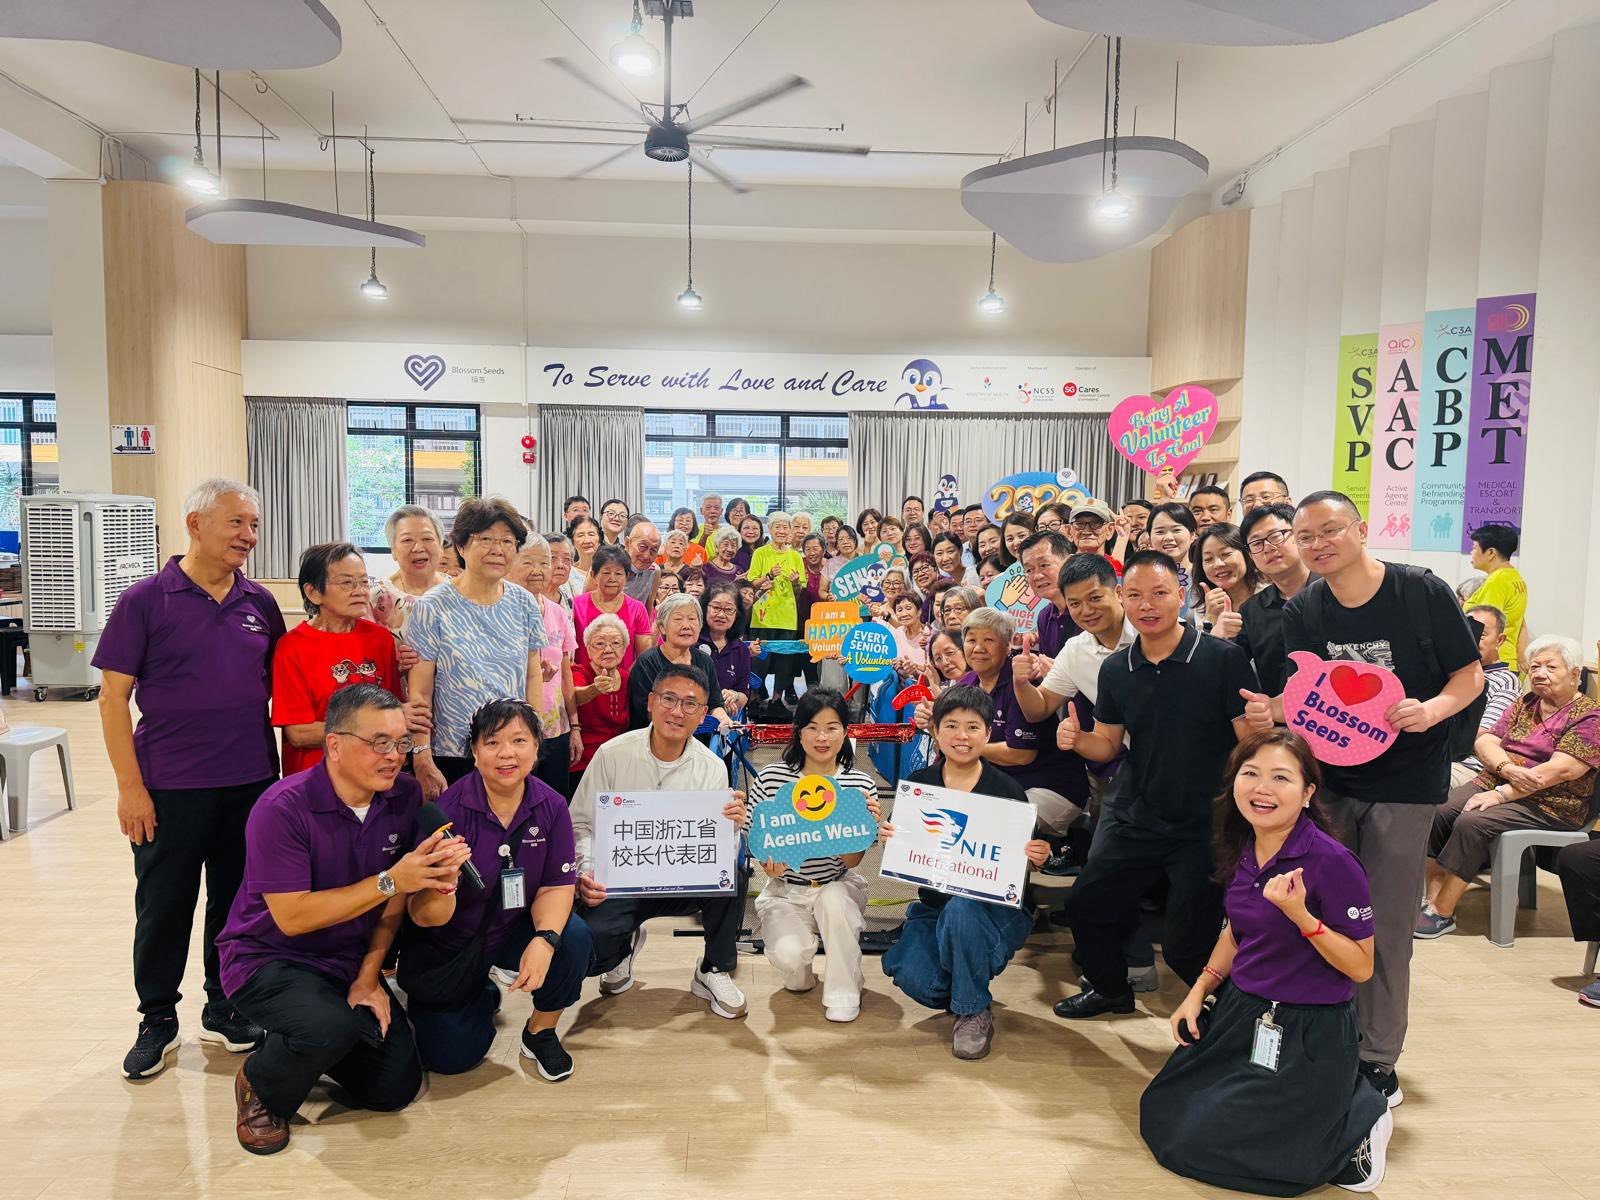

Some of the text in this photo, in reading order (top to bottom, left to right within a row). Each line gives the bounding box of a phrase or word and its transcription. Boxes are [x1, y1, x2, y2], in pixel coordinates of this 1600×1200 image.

[1451, 326, 1472, 335] C3A
[452, 366, 505, 375] Blossom Seeds
[543, 363, 888, 397] To Serve with Love and Care
[1033, 387, 1055, 395] NCSS
[1129, 389, 1191, 430] Being A
[1120, 405, 1212, 455] Volunteer
[1146, 431, 1204, 468] Is Cool
[1386, 484, 1408, 492] Active
[1421, 482, 1465, 492] Community
[1478, 481, 1518, 489] MEDICAL
[1384, 492, 1409, 501] Ageing
[1422, 490, 1465, 499] Befriending
[1479, 490, 1516, 498] ESCORT
[1420, 498, 1465, 507] Programme
[1492, 497, 1500, 506] &
[825, 611, 838, 619] am
[1008, 610, 1035, 619] HIGH
[854, 630, 888, 645] EVERY
[850, 639, 889, 655] SENIOR
[1336, 641, 1387, 652] GIVENCHY
[1315, 672, 1327, 688] I
[760, 813, 796, 829] I am
[613, 818, 717, 841] 中国浙江省
[611, 843, 717, 868] 校长代表团
[960, 839, 1002, 862] NIE
